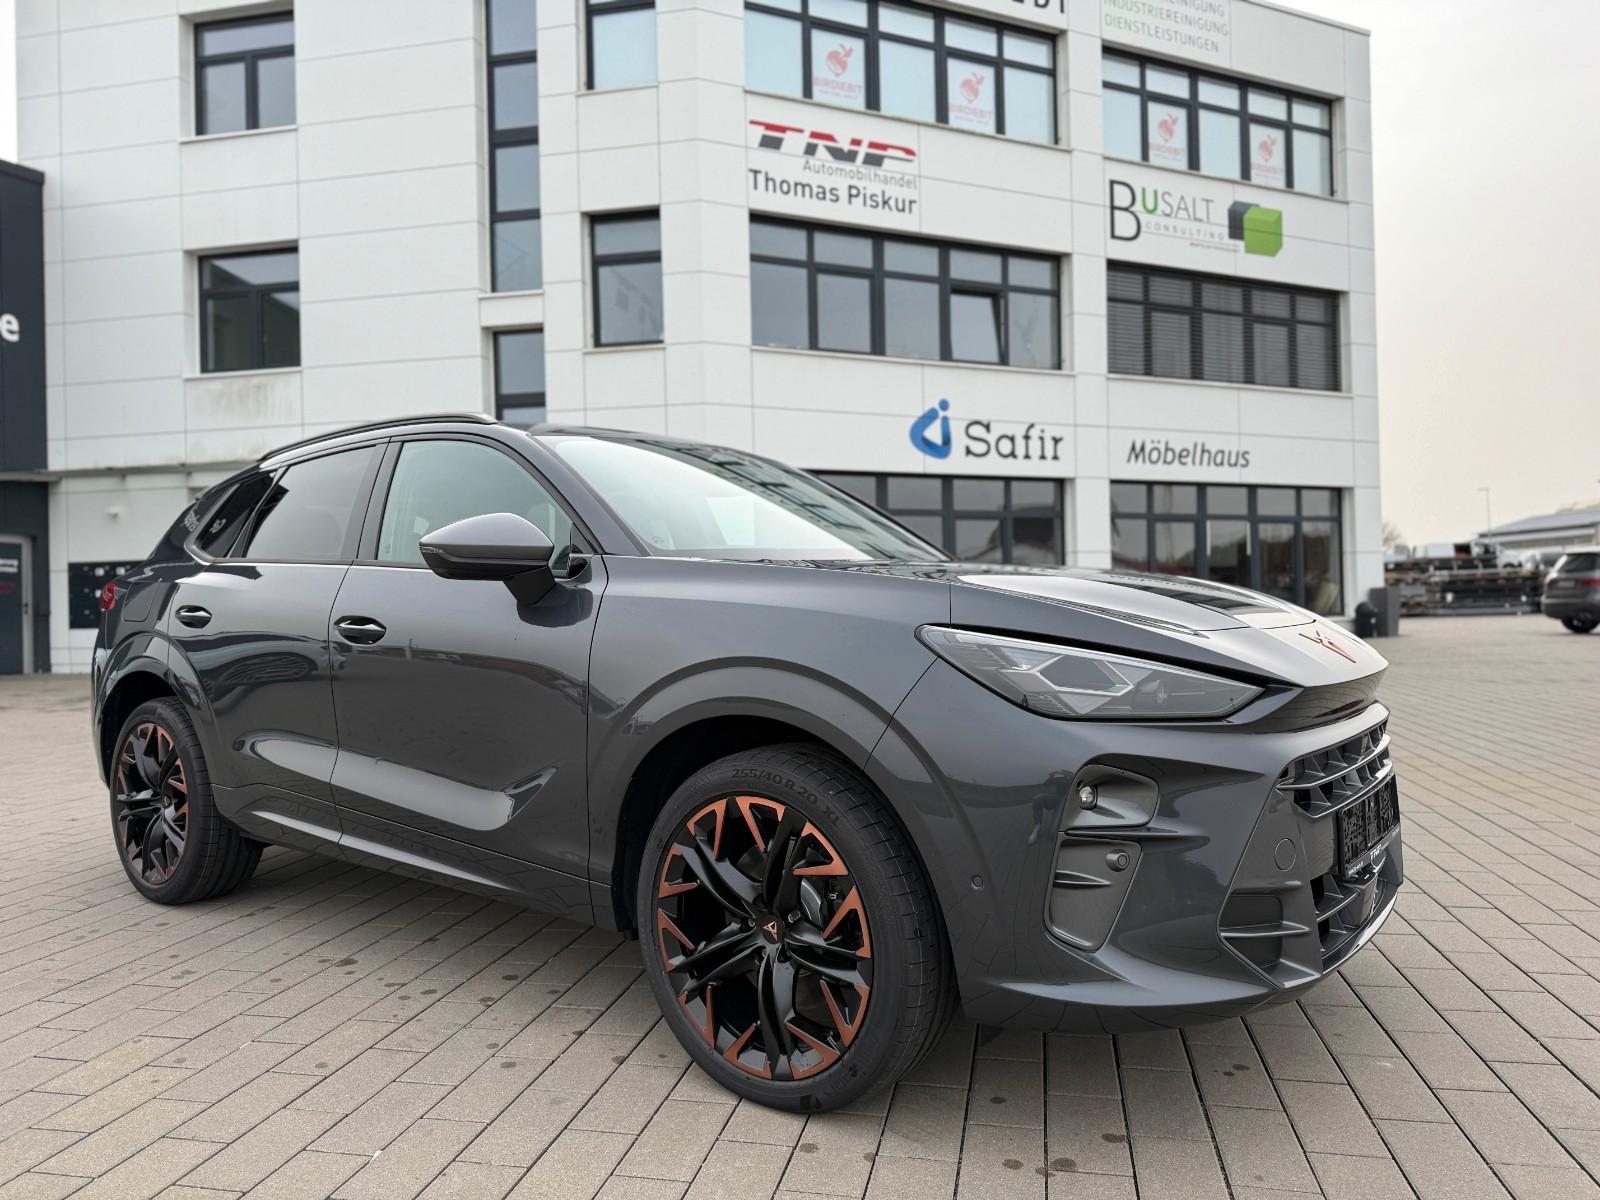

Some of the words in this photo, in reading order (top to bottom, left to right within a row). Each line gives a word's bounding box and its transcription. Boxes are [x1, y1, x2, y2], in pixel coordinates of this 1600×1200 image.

[1104, 13, 1218, 52] DIENSTLEISTUNGEN
[749, 120, 917, 168] TNP
[749, 168, 839, 202] Thomas
[848, 184, 917, 214] Piskur
[803, 159, 917, 190] Automobilhandel
[1109, 179, 1214, 242] BUSALT
[1145, 221, 1225, 241] CONSULTING
[964, 420, 1063, 461] Safir
[1126, 440, 1250, 469] Möbelhaus
[732, 768, 783, 785] 255/40
[784, 779, 796, 792] R
[797, 786, 818, 804] 20
